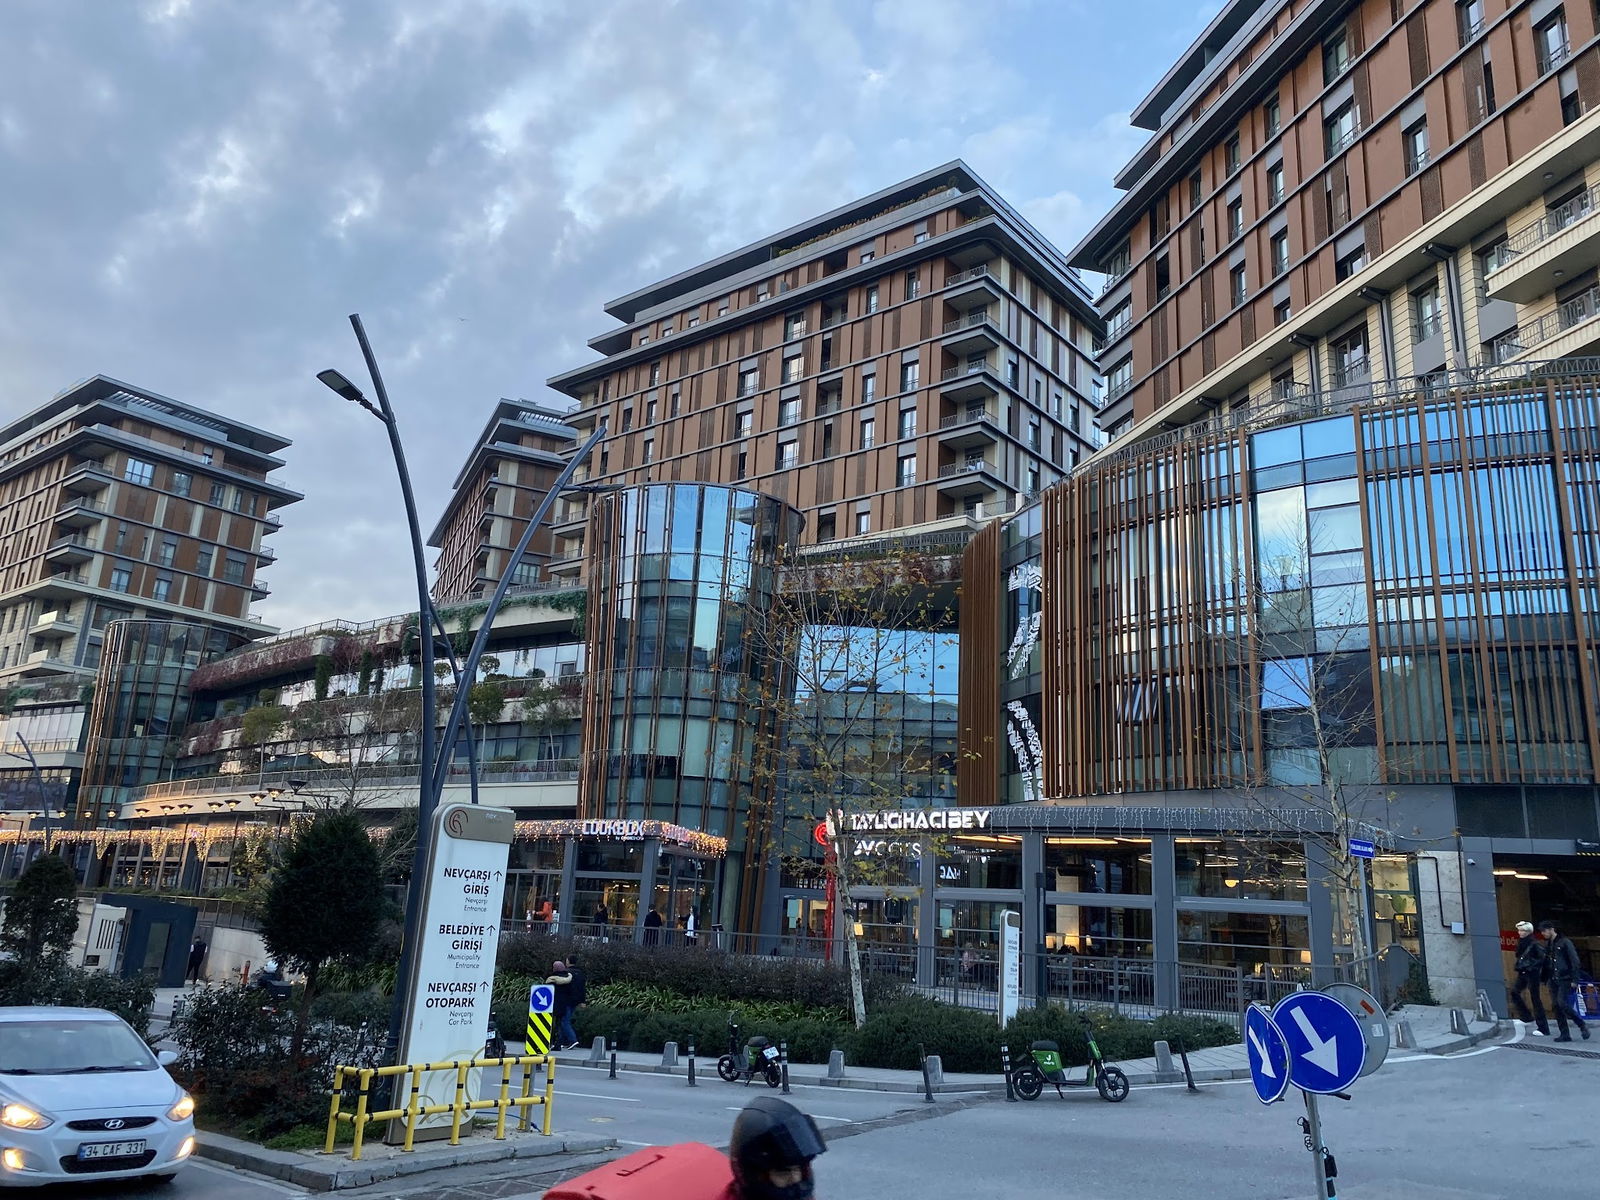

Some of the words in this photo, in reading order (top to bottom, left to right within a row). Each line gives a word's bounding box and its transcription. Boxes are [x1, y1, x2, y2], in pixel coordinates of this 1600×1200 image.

[582, 819, 645, 836] COOKBOX
[443, 867, 491, 883] NEVÇARŞI
[463, 881, 490, 898] GİRİŞ
[463, 904, 487, 913] Entrance
[439, 922, 485, 936] BELEDİYE
[451, 937, 483, 953] GİRİŞİ
[455, 961, 480, 969] Entrance
[427, 982, 477, 996] NEVÇARŞI
[425, 997, 475, 1008] OTOPARK
[448, 1018, 460, 1026] Car
[86, 1145, 98, 1157] 34
[102, 1143, 122, 1156] CAF
[126, 1142, 143, 1154] 331
